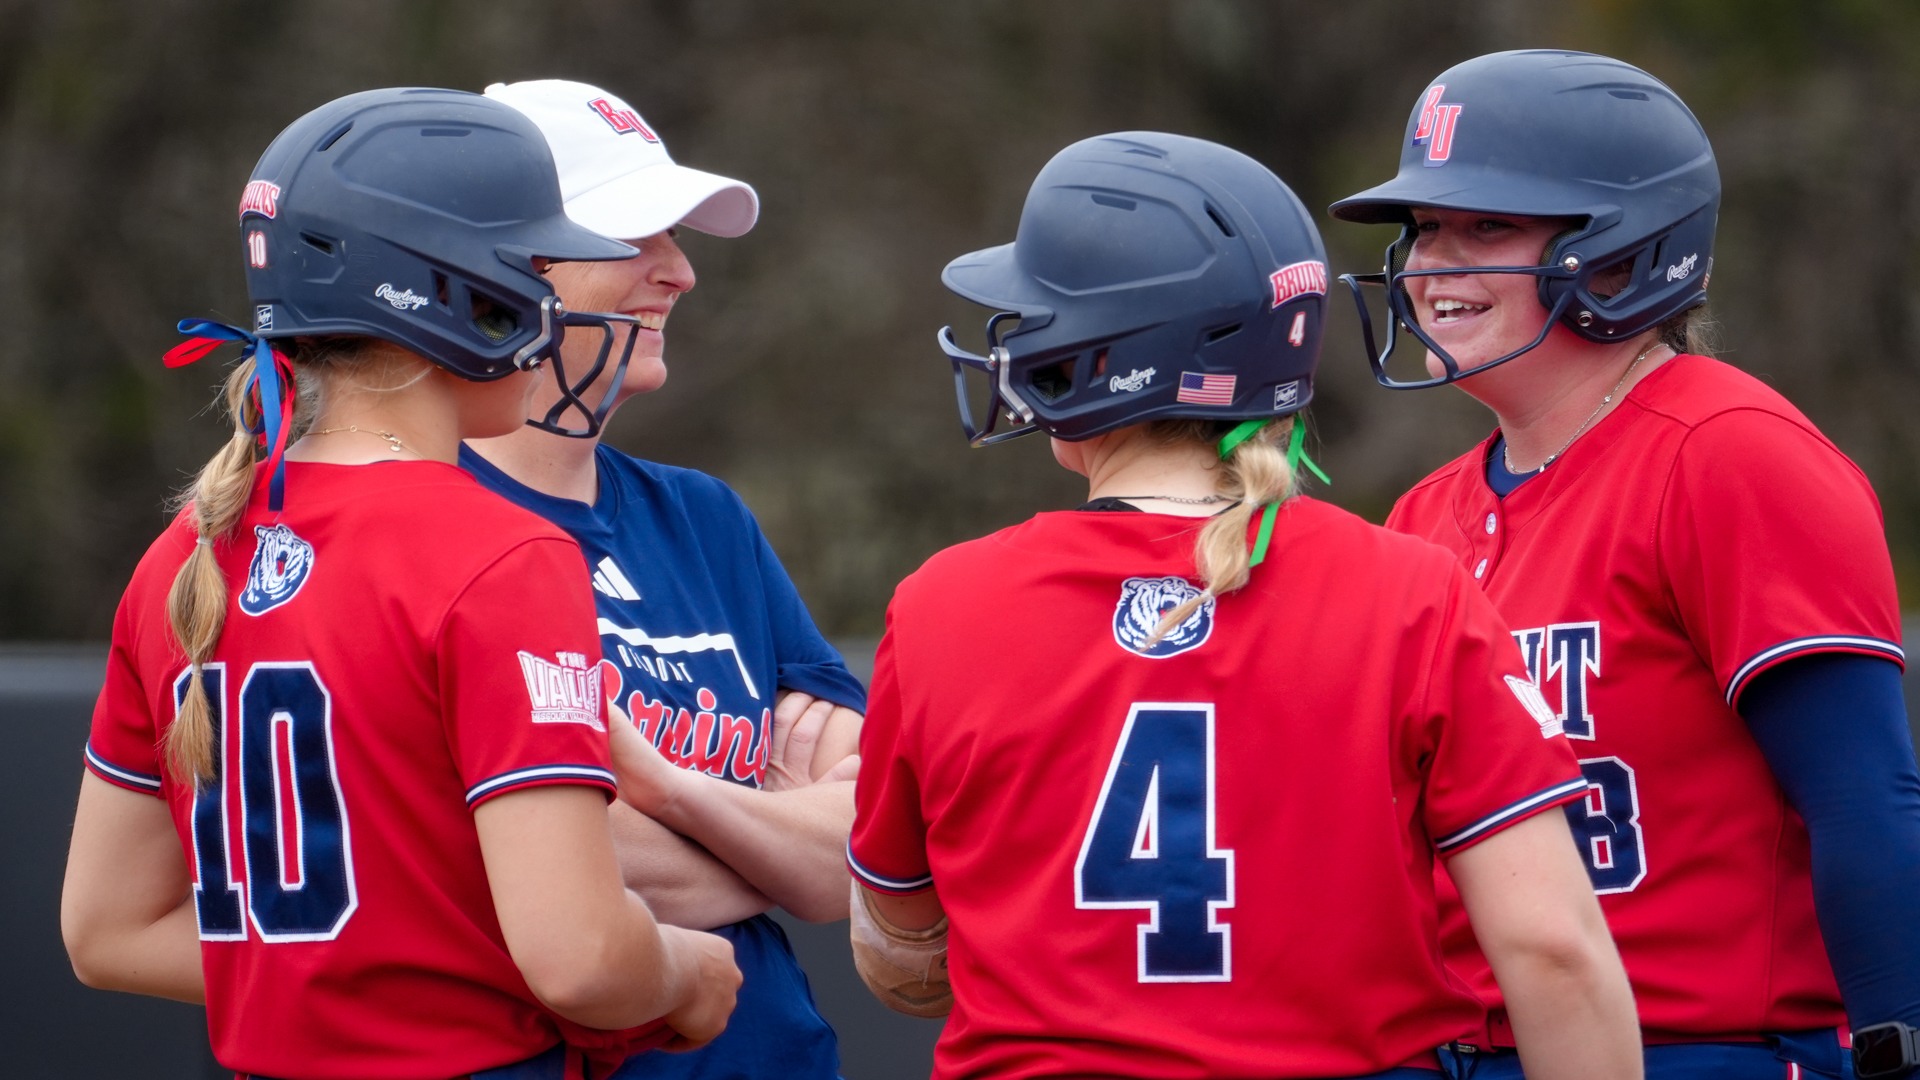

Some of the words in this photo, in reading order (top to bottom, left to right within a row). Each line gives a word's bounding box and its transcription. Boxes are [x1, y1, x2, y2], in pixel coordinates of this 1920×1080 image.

[588, 97, 660, 143] BU
[1413, 84, 1464, 165] BU
[248, 231, 267, 269] 10
[375, 283, 429, 310] Rawlings
[1270, 260, 1327, 309] BRUINS
[1288, 311, 1306, 347] 4
[1109, 366, 1156, 393] Rawlings
[555, 651, 587, 670] THE
[517, 650, 604, 722] VALLEY
[602, 658, 773, 791] ruins
[173, 661, 359, 943] 10
[1074, 702, 1235, 983] 4
